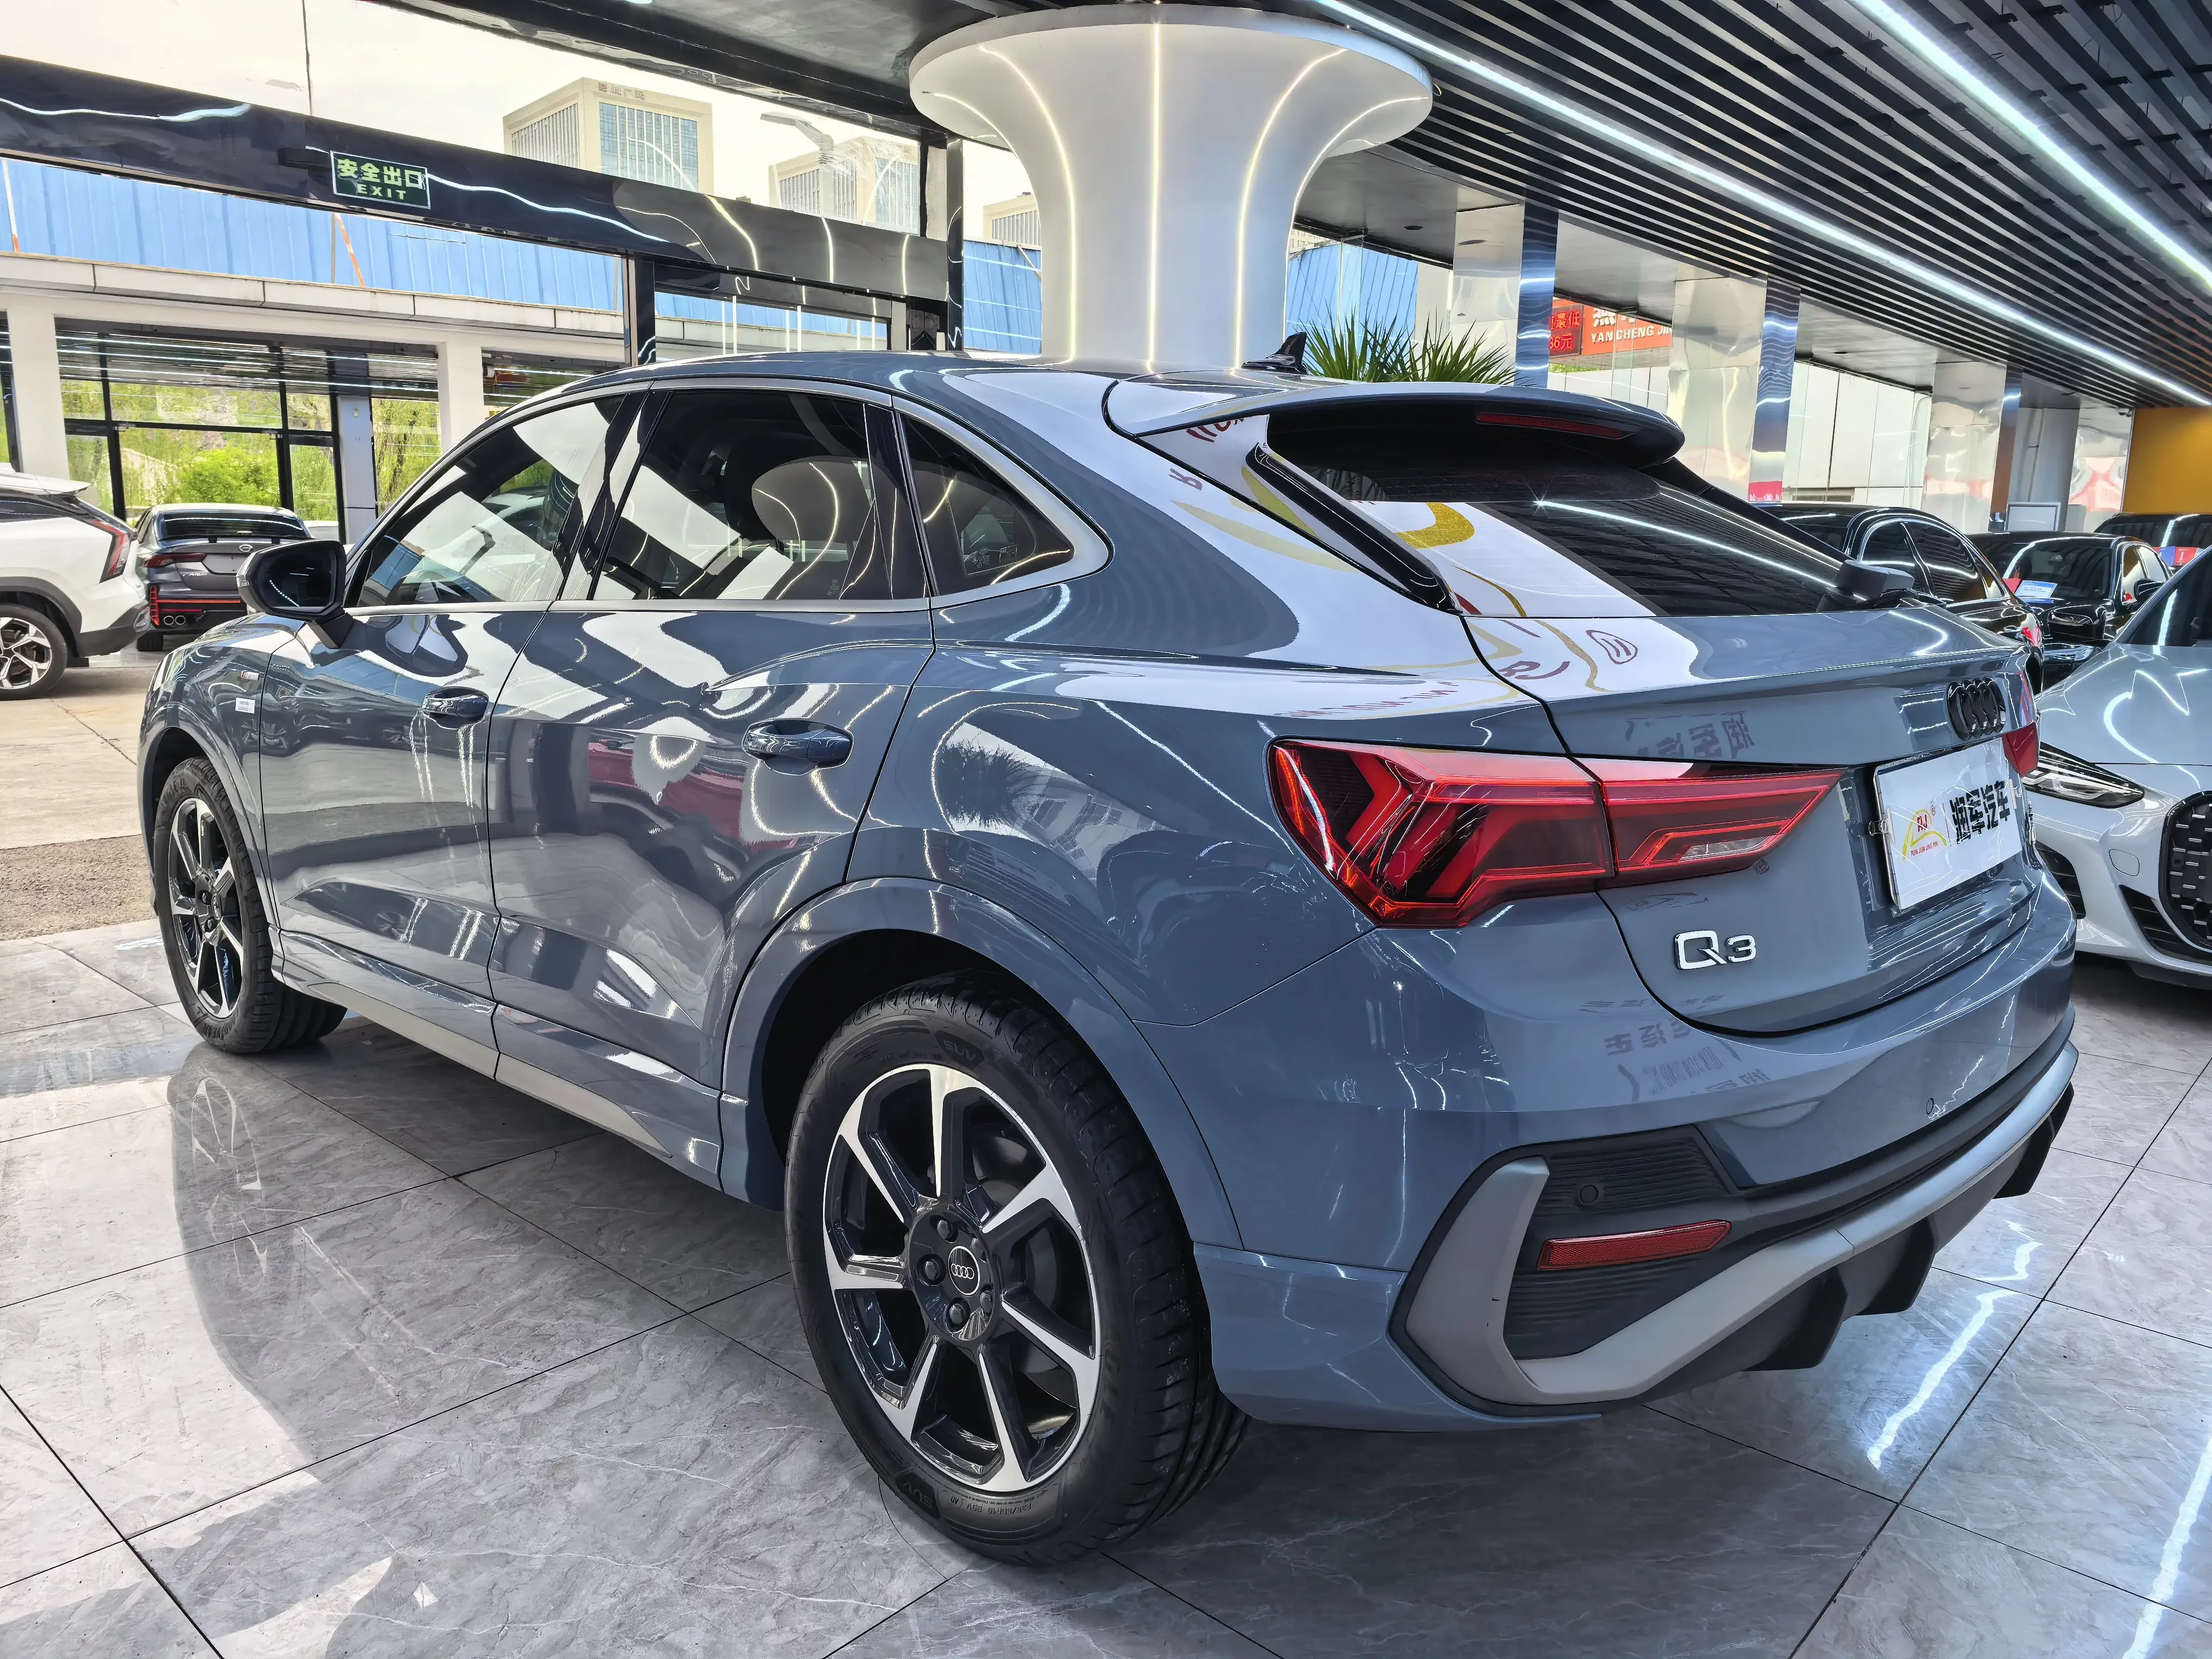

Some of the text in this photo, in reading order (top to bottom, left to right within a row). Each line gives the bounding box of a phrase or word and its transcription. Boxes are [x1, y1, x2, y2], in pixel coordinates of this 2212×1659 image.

[337, 159, 425, 190] 安全出口
[358, 184, 406, 200] EXIT
[1591, 331, 1613, 343] YAN
[1616, 326, 1654, 341] CHENG
[1675, 930, 1756, 970] Q3
[943, 1039, 976, 1061] SUV
[901, 1482, 934, 1509] SUV
